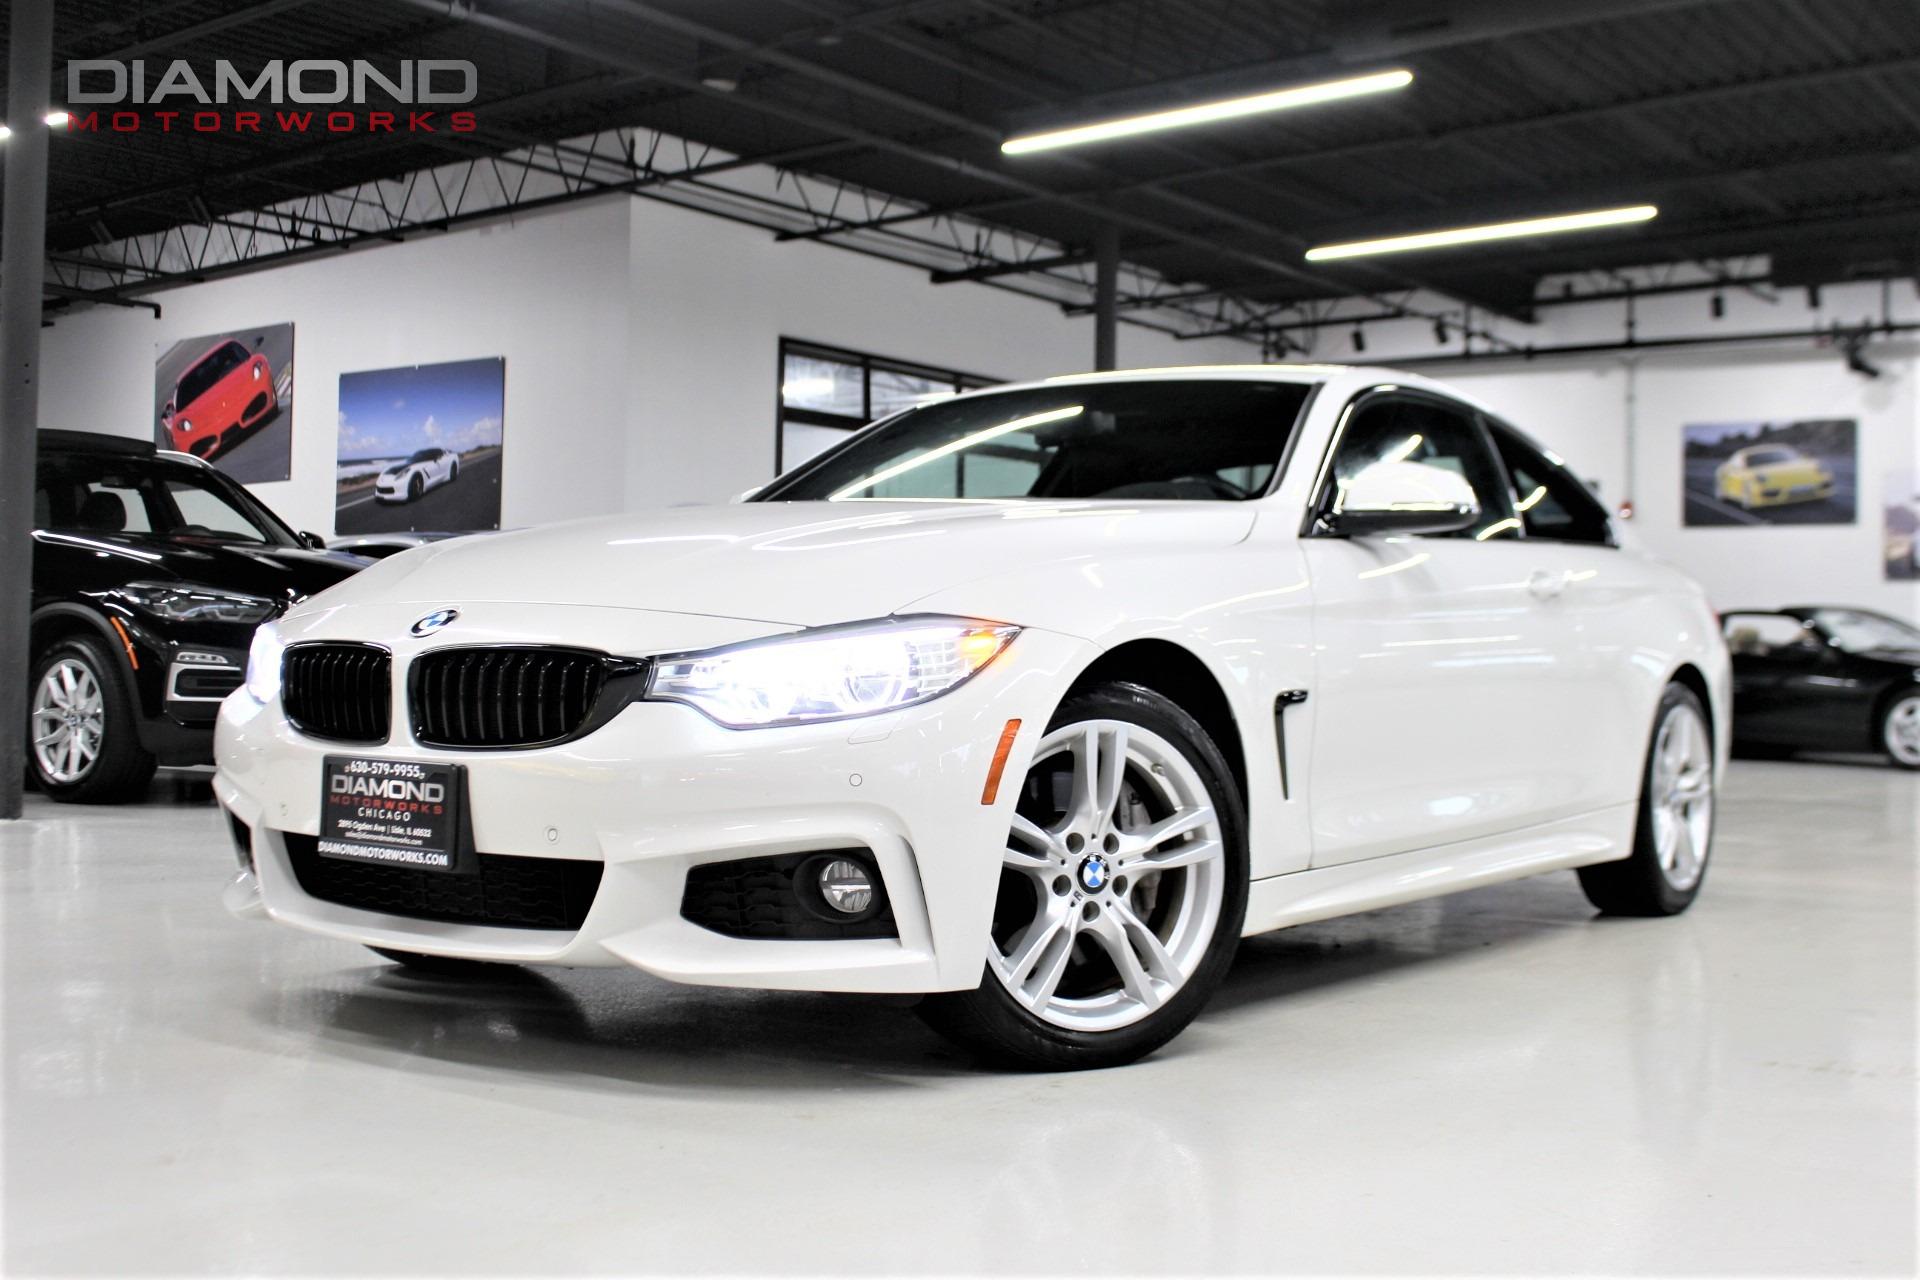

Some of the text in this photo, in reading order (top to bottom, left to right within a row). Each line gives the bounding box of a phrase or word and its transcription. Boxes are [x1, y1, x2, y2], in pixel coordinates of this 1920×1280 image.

[350, 760, 421, 778] 630-579-9955
[331, 774, 445, 803] DIAMOND
[328, 795, 444, 815] MOTORWORKS
[357, 807, 412, 822] CHICAGO
[352, 820, 373, 832] Ogden
[373, 823, 386, 833] Ave
[317, 841, 449, 866] DIAMONDMOTORWORKS.COM
